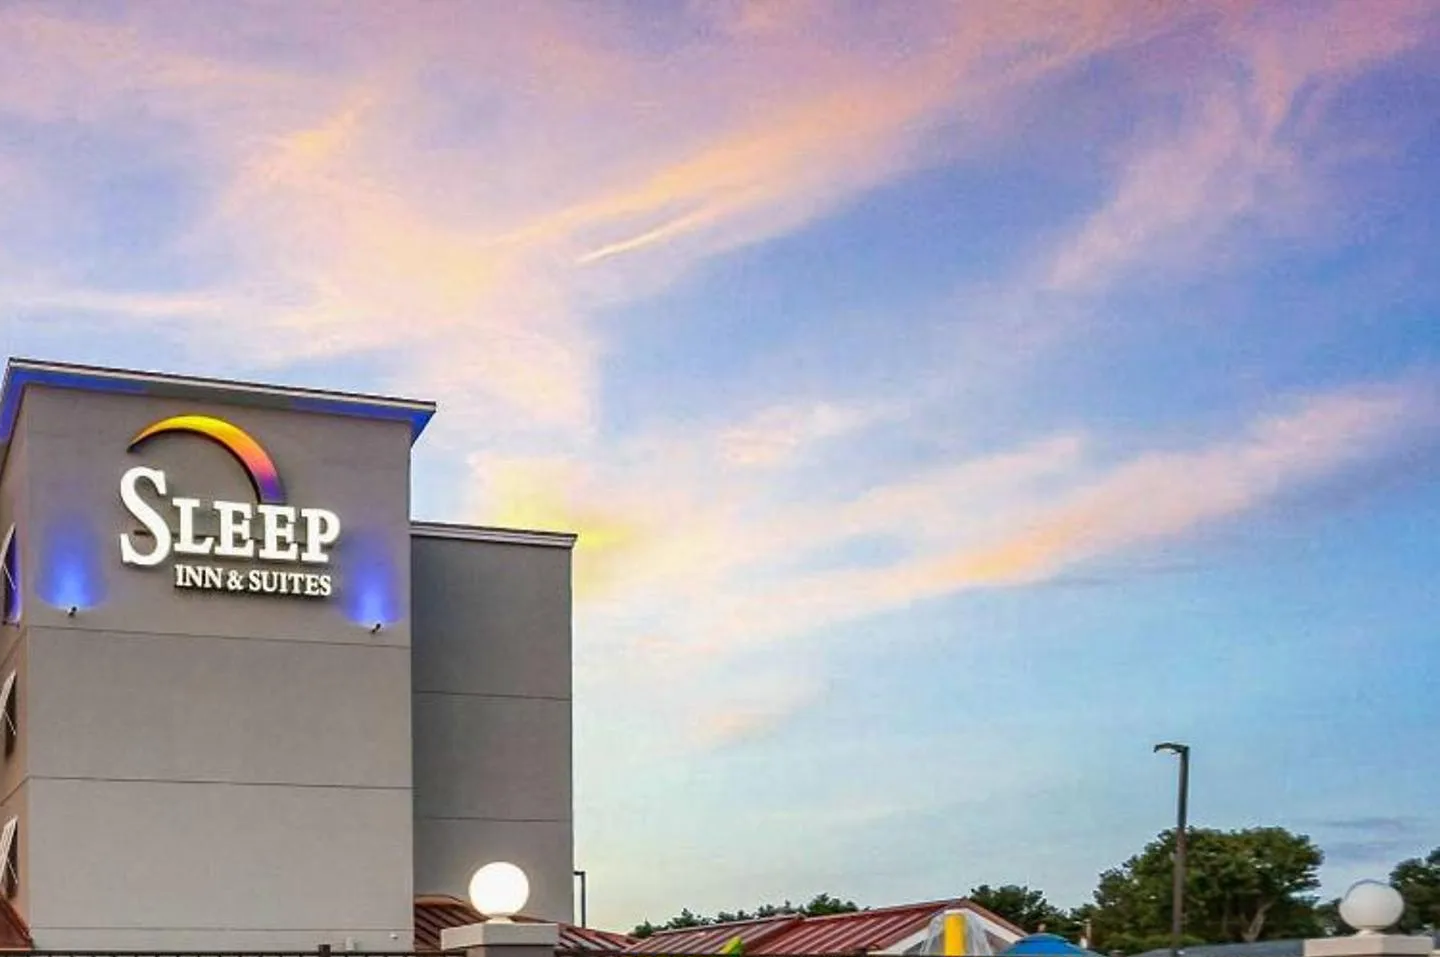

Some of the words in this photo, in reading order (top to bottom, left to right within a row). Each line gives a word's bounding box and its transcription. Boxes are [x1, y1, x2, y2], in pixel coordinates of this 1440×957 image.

[120, 466, 342, 566] SLEEP
[175, 564, 224, 588] INN
[227, 569, 244, 590] &
[248, 570, 333, 597] SUITES
